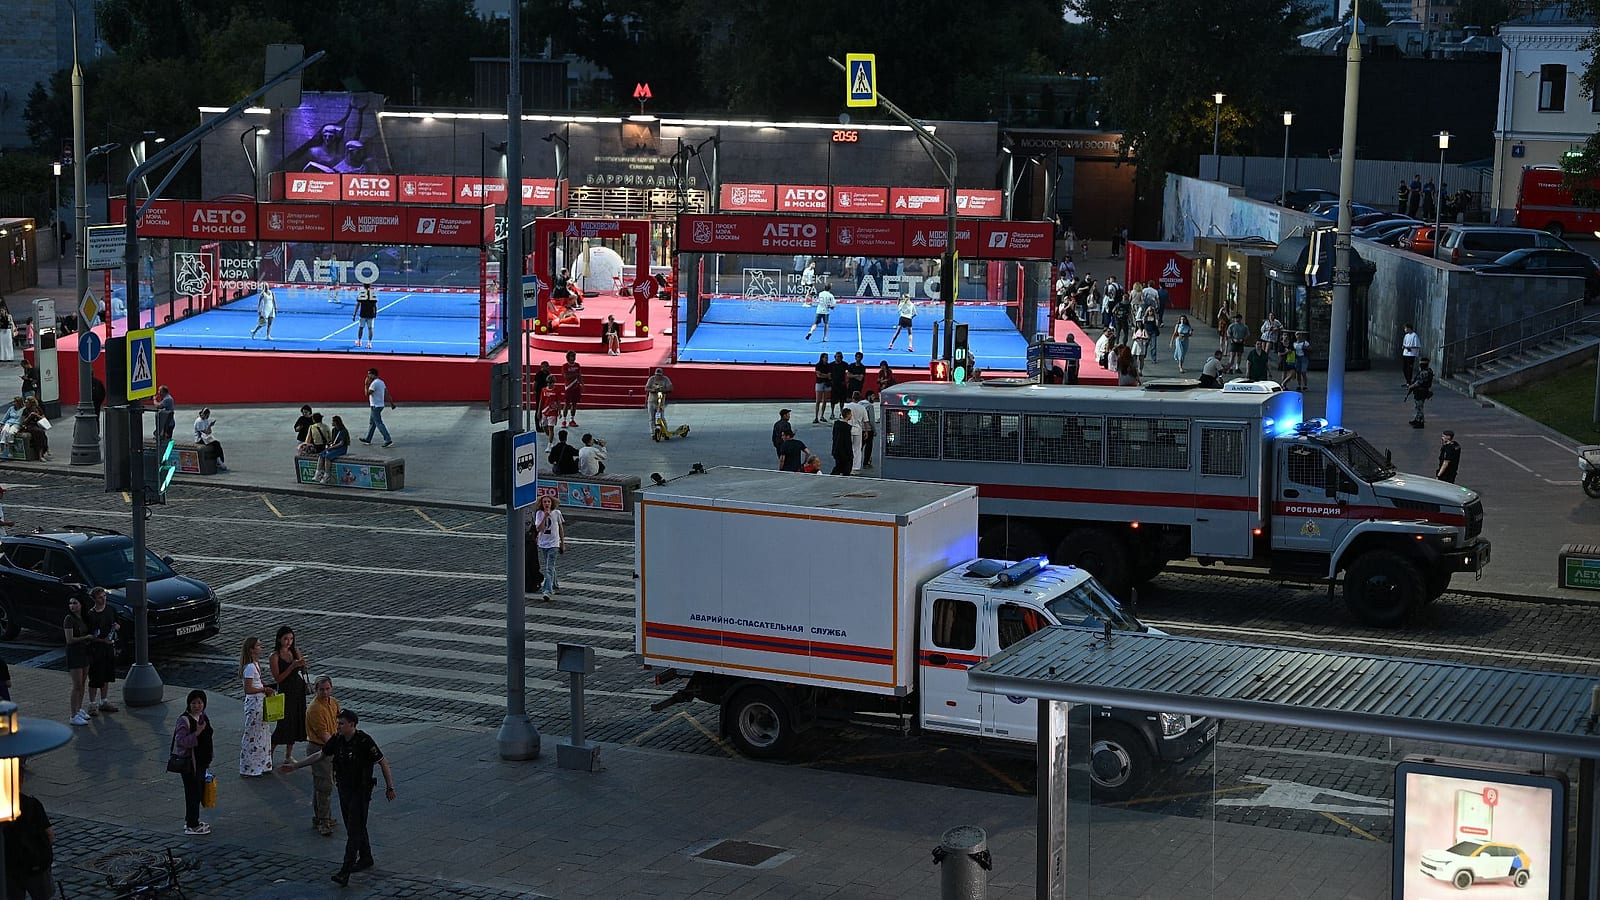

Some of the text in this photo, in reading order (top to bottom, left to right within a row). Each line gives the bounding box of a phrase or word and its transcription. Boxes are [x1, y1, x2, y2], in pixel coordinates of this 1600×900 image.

[1085, 139, 1119, 150] ЗООПА
[349, 177, 390, 190] ЛЕТО
[586, 174, 696, 187] БАРРИКАДНАЯ
[785, 188, 827, 201] ЛЕТО
[192, 208, 247, 224] ЛЕТО
[358, 215, 399, 225] МОСКОВСКИЙ
[192, 224, 247, 233] В МОСКВЕ
[358, 225, 377, 233] СПОРТ
[581, 221, 619, 231] МОСКОВСКИЙ
[763, 222, 817, 238] ЛЕТО
[928, 230, 970, 240] МОСКСКИЙ
[762, 238, 817, 247] В МОСКВЕ
[219, 258, 260, 268] ПРОЕКТ
[219, 270, 249, 279] МЭРА
[287, 259, 380, 284] ЛЕТО
[787, 273, 829, 284] ПРЕКТ
[955, 348, 966, 361] 01
[537, 487, 557, 497] ЕТО
[1285, 506, 1341, 516] РОСГВАРДИЯ
[690, 613, 847, 638] АВАРИЙНО-СПАСАТЕЛЬНАЯ СЛУЖБА
